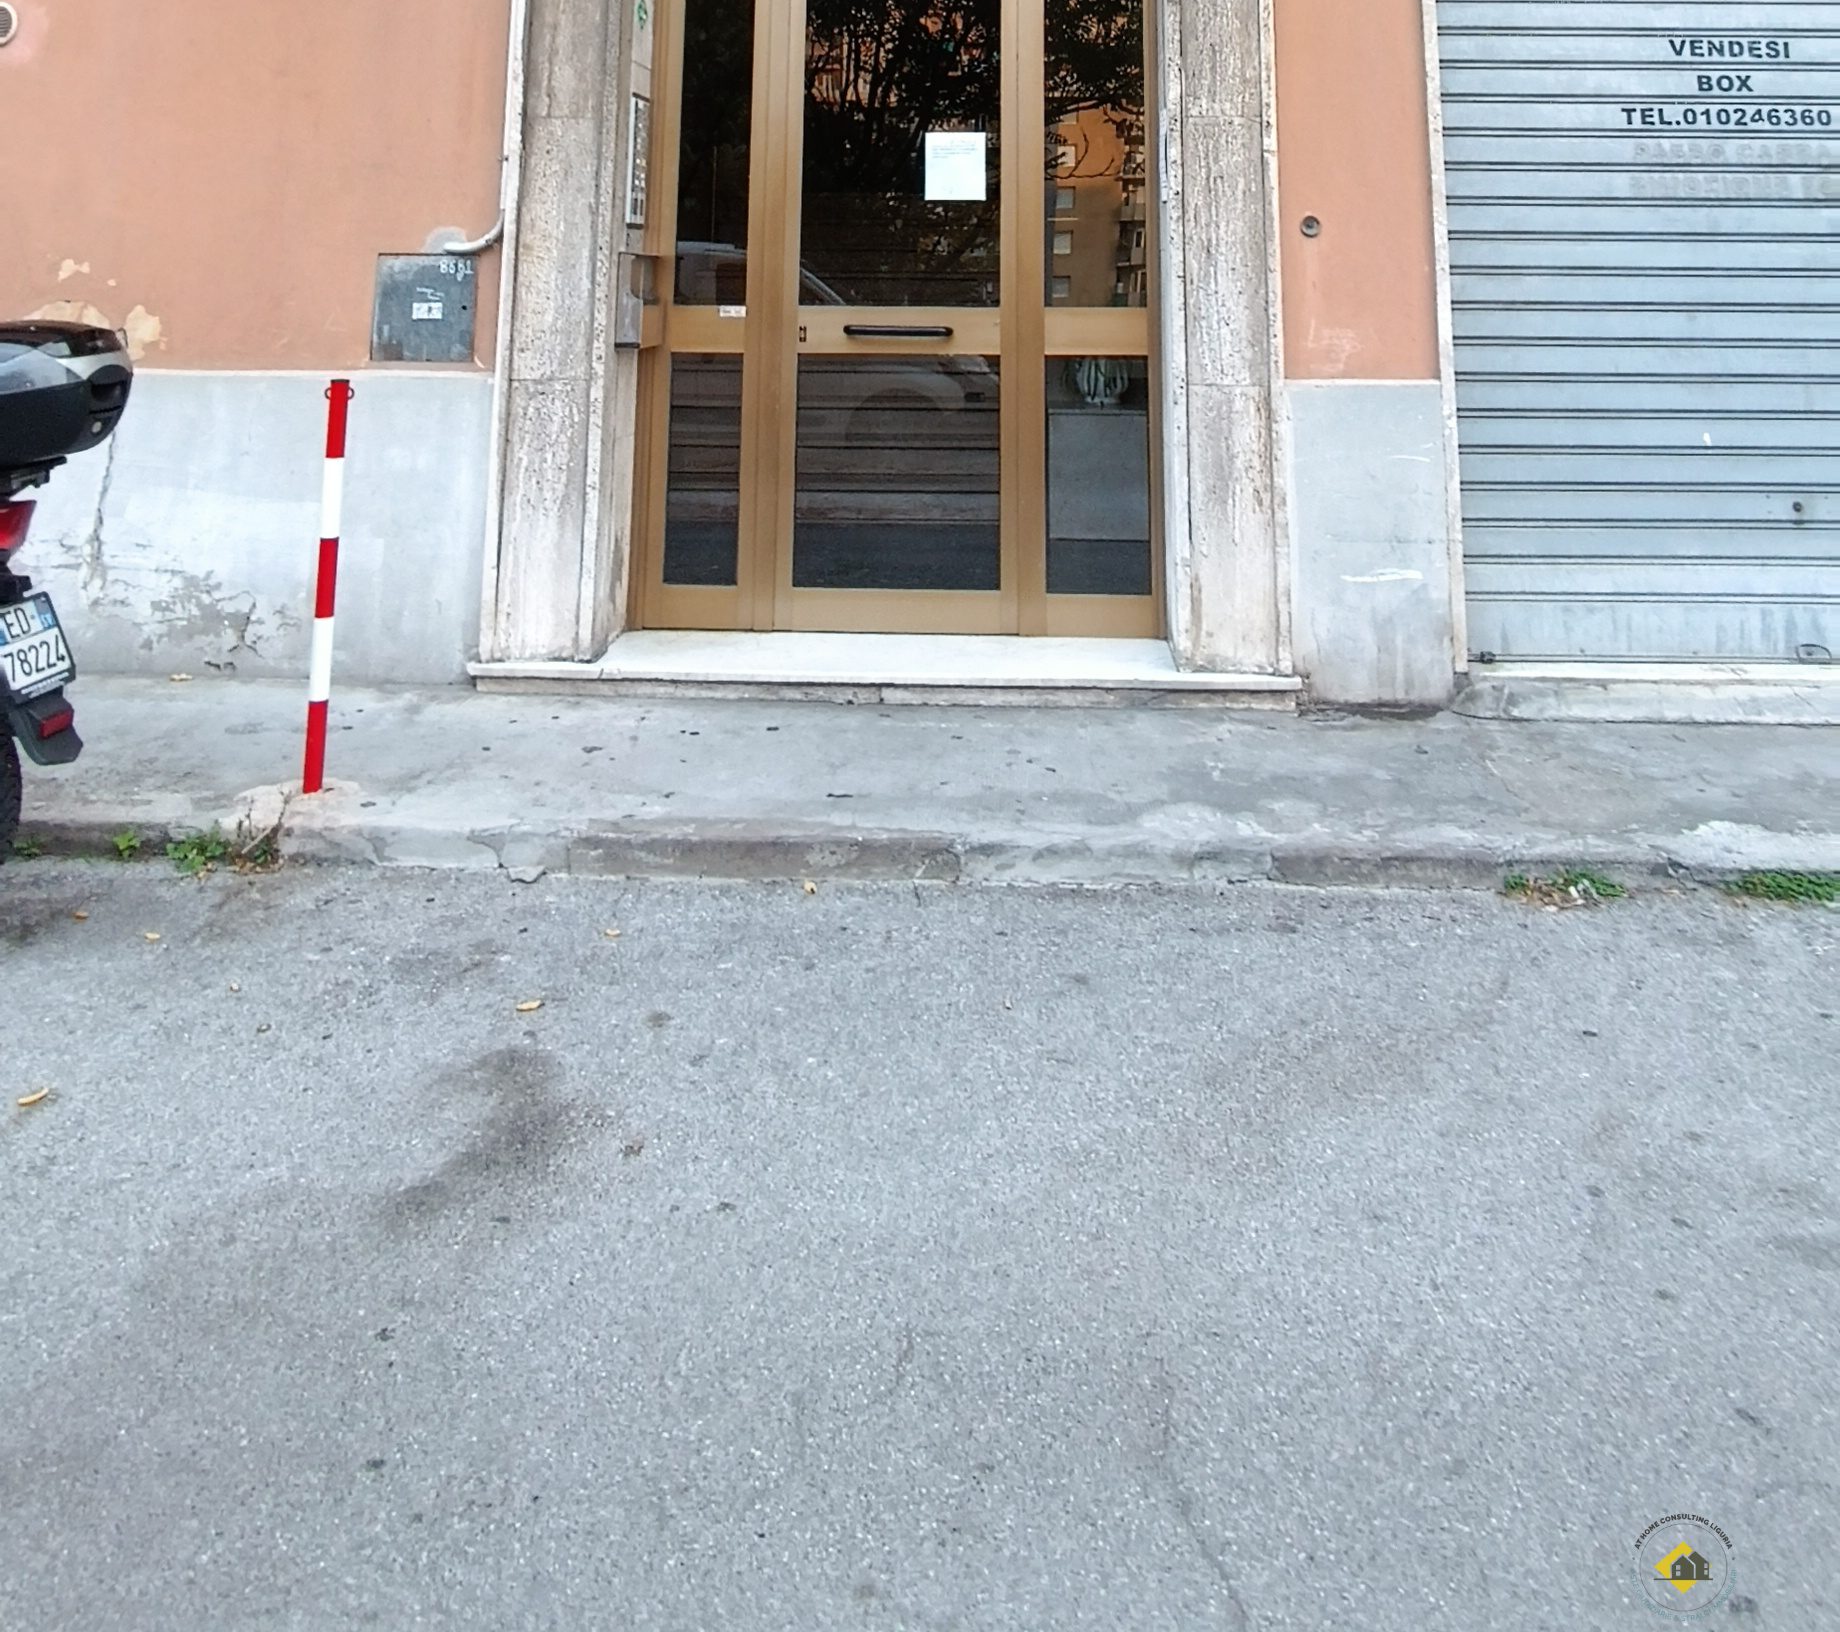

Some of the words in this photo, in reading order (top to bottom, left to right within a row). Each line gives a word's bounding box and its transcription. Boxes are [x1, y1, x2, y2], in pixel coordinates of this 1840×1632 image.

[1668, 39, 1790, 59] VENDESI
[1696, 74, 1754, 92] BOX
[1621, 107, 1832, 127] TEL.010246360
[3, 607, 32, 640] ED
[3, 634, 67, 683] 78224
